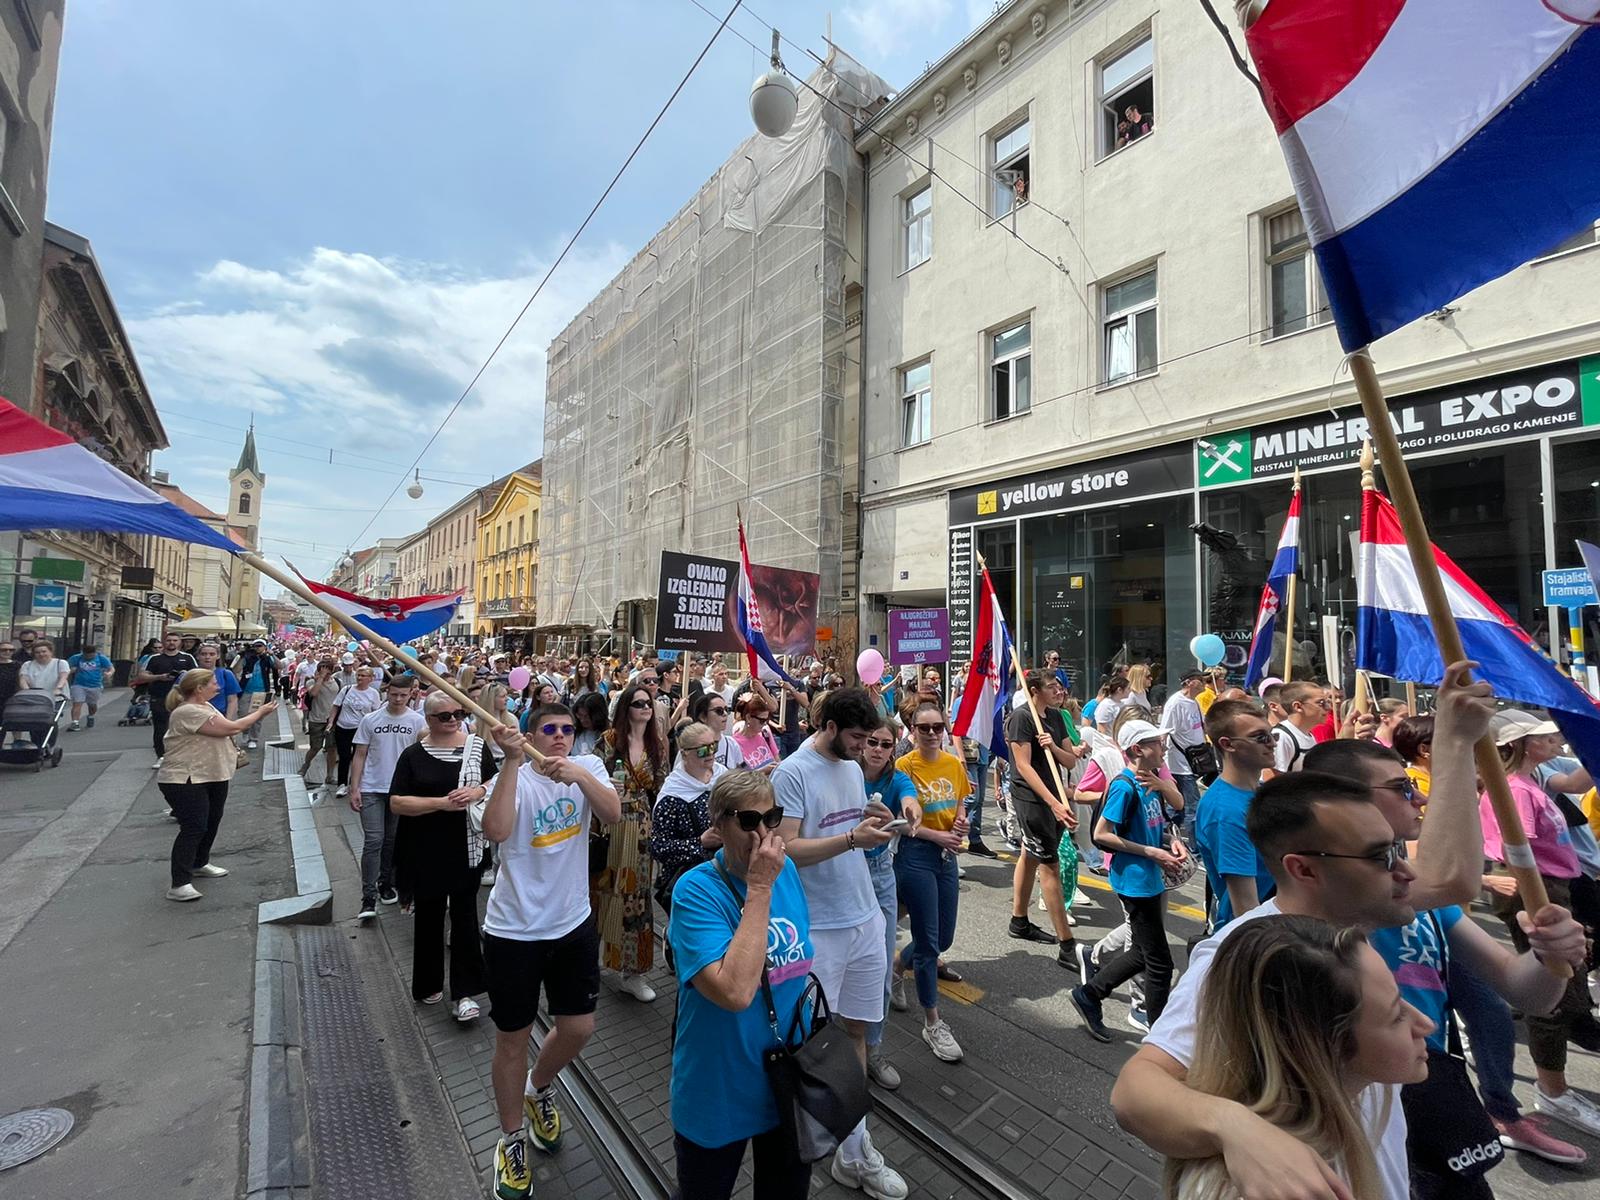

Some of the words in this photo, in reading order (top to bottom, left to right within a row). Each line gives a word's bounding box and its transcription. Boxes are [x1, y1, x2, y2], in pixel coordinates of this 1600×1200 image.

[1440, 377, 1576, 427] EXPO
[1253, 460, 1293, 473] KRISTALI
[1299, 451, 1344, 466] MINERALI
[1434, 424, 1510, 443] POLUDRAGO
[1513, 411, 1577, 430] KAMENJE
[1002, 482, 1065, 511] yellow
[1070, 469, 1129, 495] store
[687, 563, 727, 583] OVAKO
[667, 577, 726, 599] IZGLEDAM
[1550, 584, 1594, 596] tramvaja
[678, 596, 687, 612] S
[689, 597, 725, 615] DESET
[673, 613, 724, 632] TJEDANA
[374, 724, 413, 735] adidas
[534, 797, 577, 828] HOD
[766, 917, 799, 953] OD
[1447, 1139, 1502, 1172] adidas
